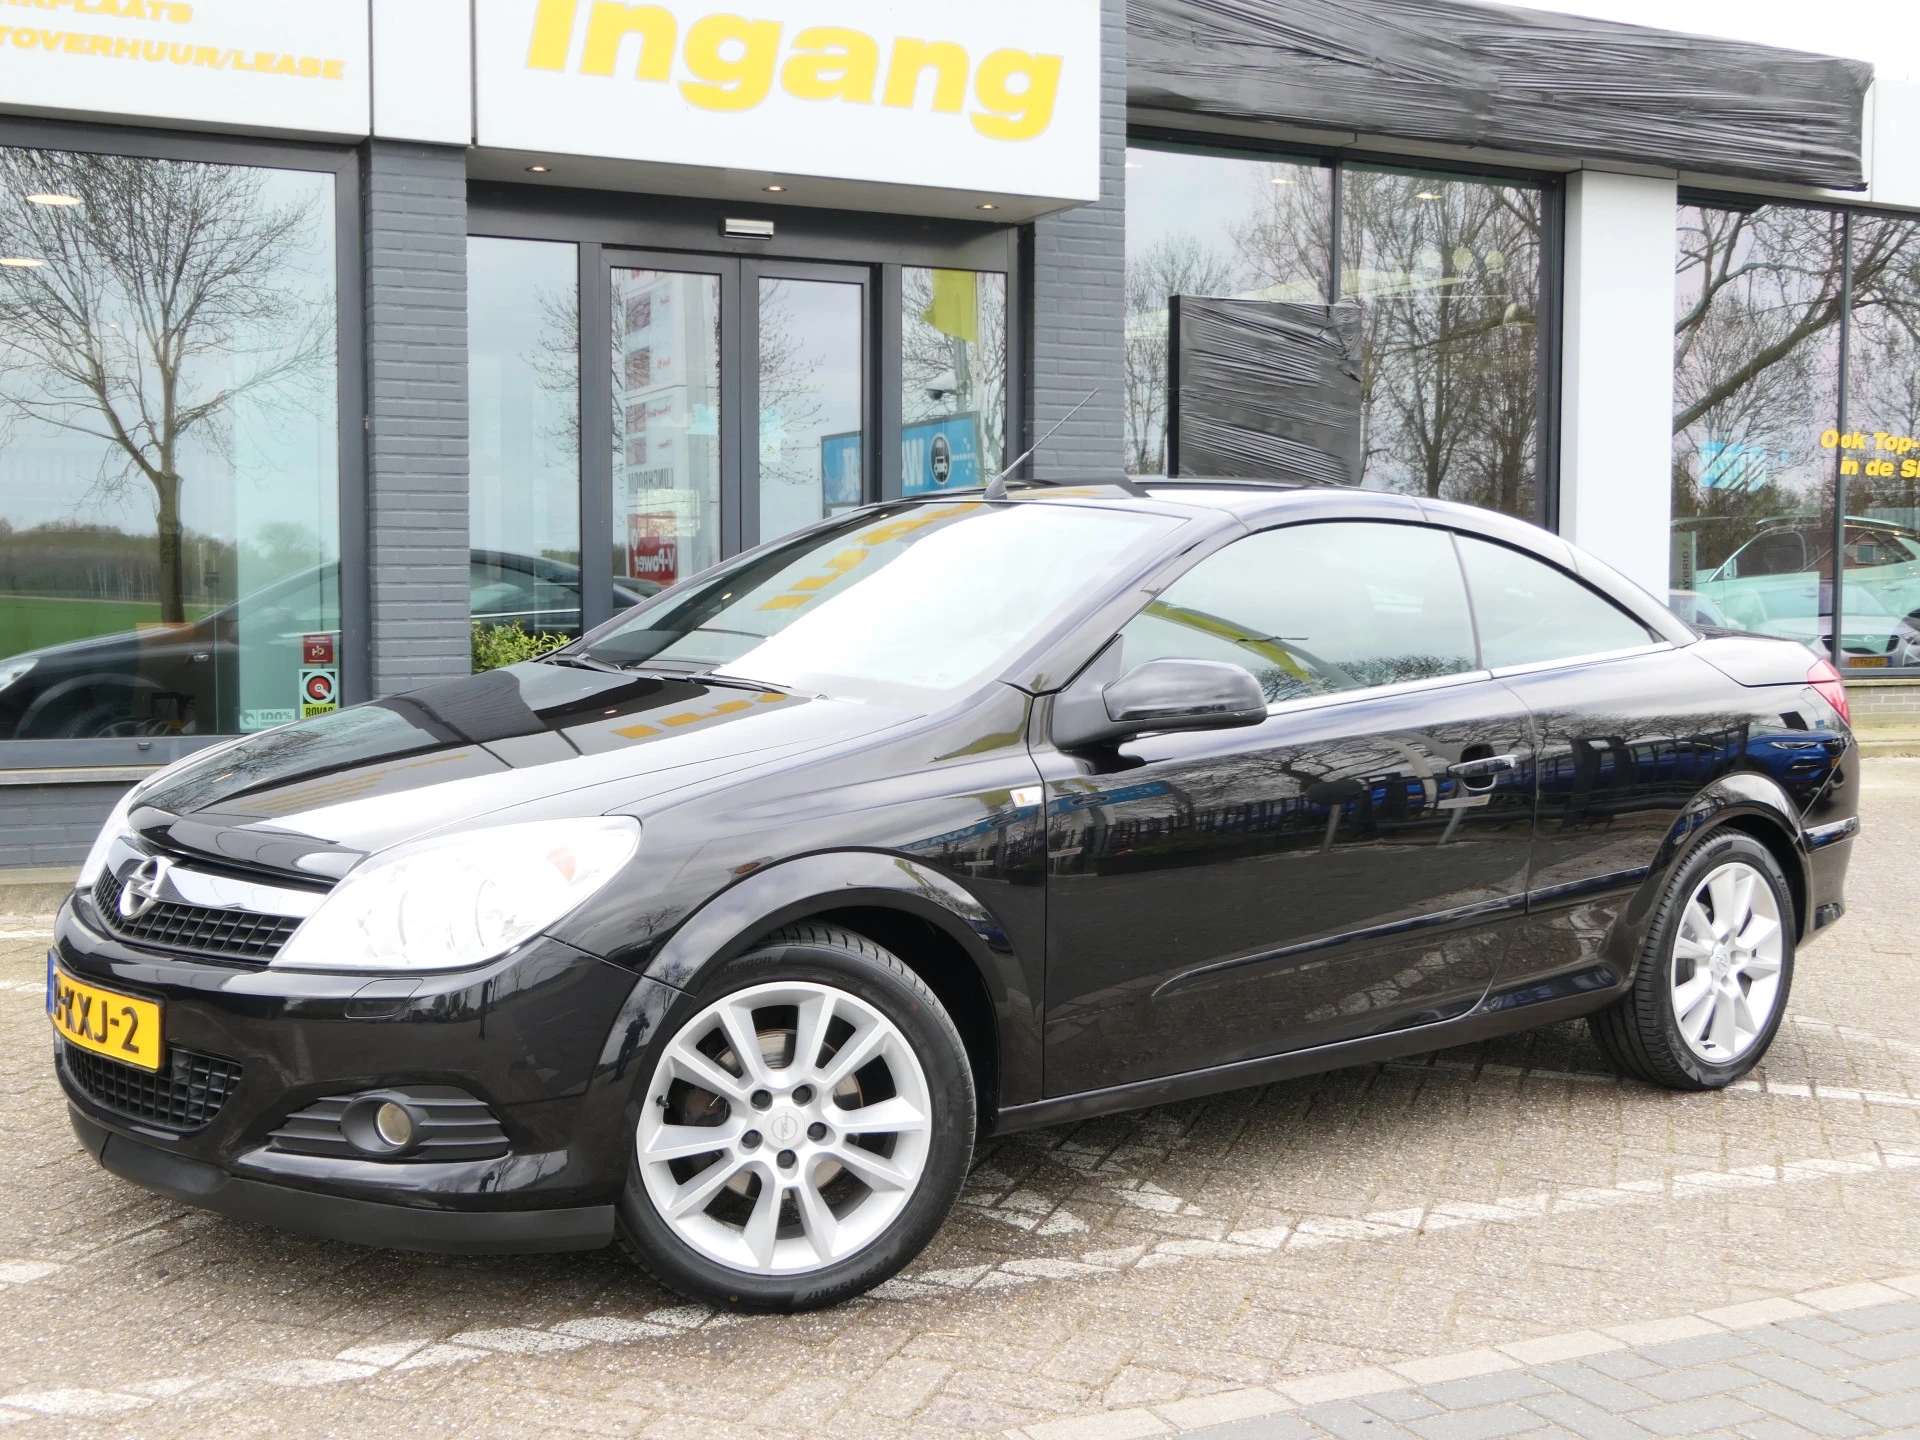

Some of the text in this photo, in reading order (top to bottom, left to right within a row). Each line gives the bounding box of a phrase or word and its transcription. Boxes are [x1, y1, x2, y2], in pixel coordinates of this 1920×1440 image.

[526, 0, 1064, 141] Ingang
[1821, 429, 1866, 449] Ook
[1840, 456, 1859, 475] in
[1865, 458, 1895, 477] de
